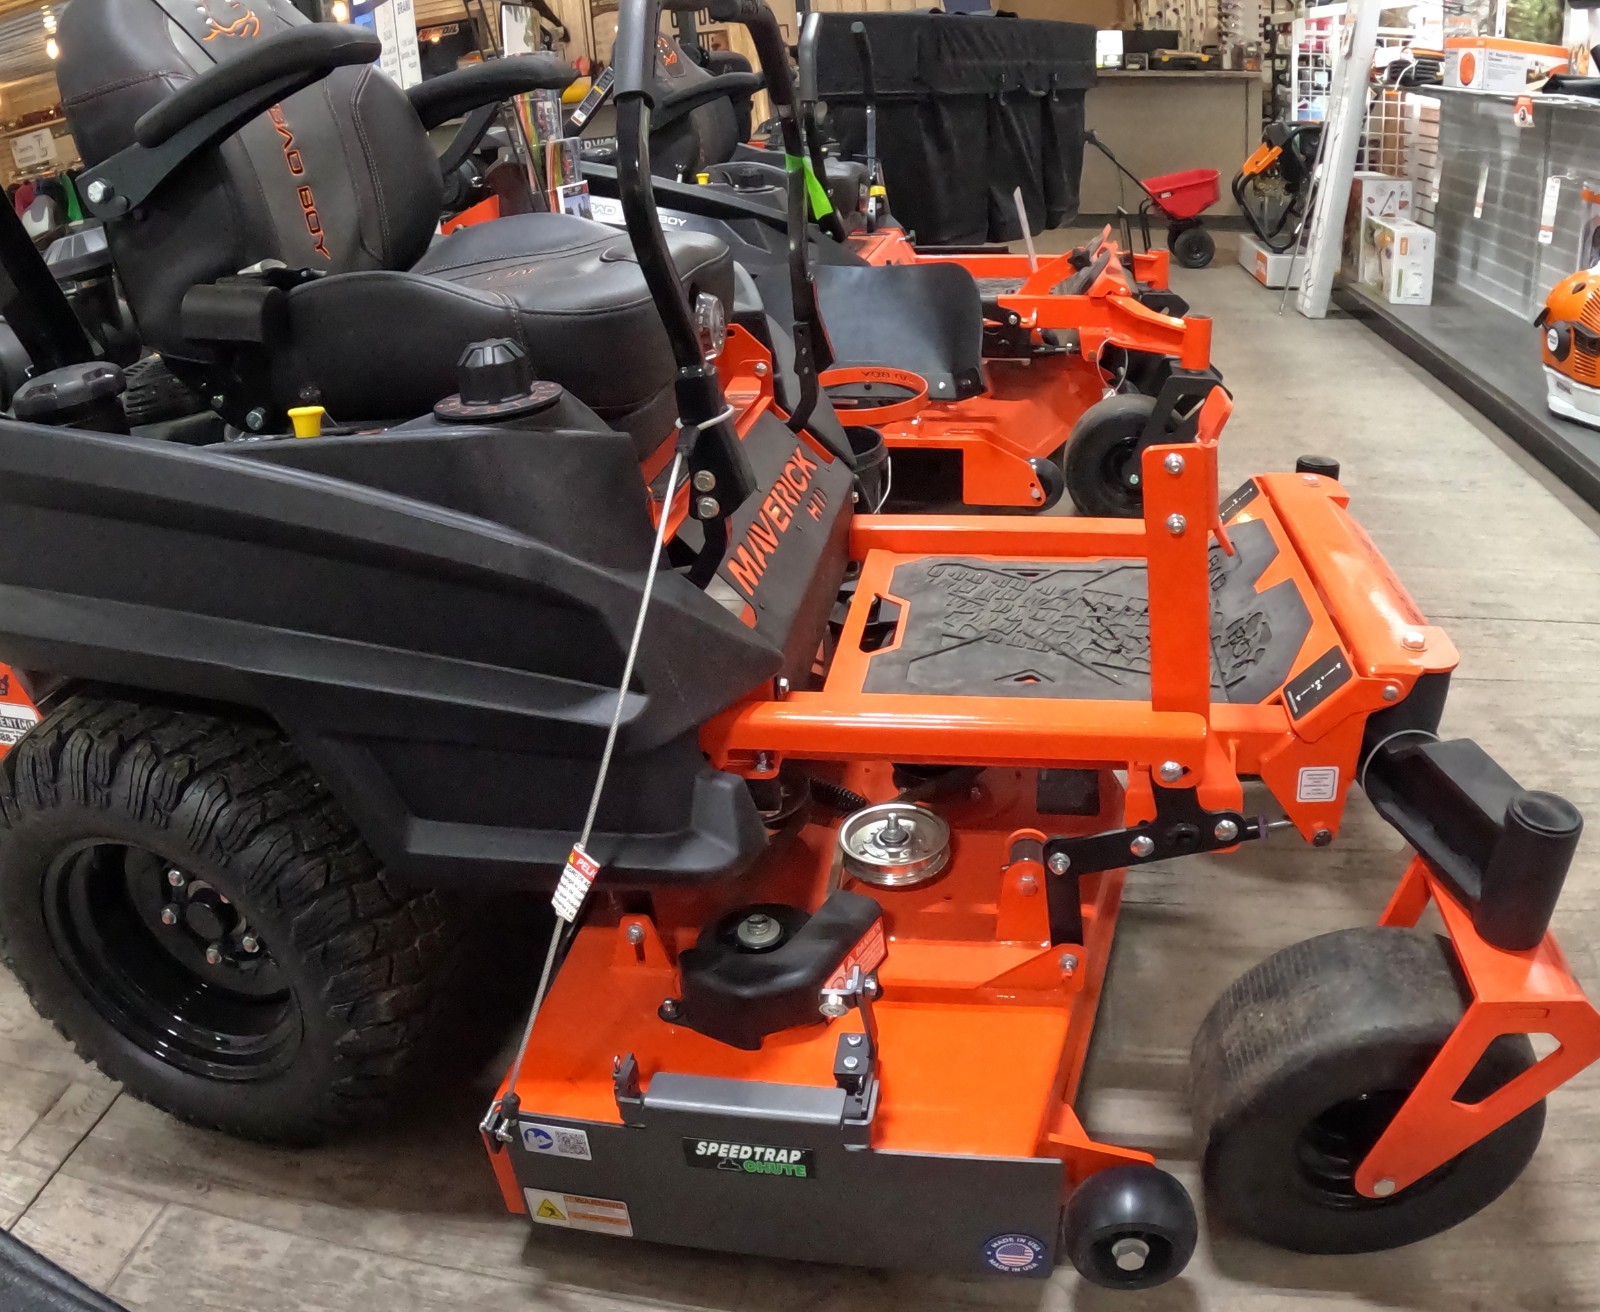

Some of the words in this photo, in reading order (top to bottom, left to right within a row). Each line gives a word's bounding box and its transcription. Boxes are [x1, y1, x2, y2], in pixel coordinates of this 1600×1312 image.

[296, 185, 332, 260] BOY
[658, 215, 687, 226] BOY
[807, 488, 828, 522] HD
[727, 446, 818, 596] MAVERICK
[696, 1141, 802, 1163] SPEEDTRAP
[991, 1237, 1014, 1248] MADE
[1027, 1240, 1041, 1251] USA
[988, 1259, 1010, 1271] MADE
[1022, 1262, 1039, 1271] USA
